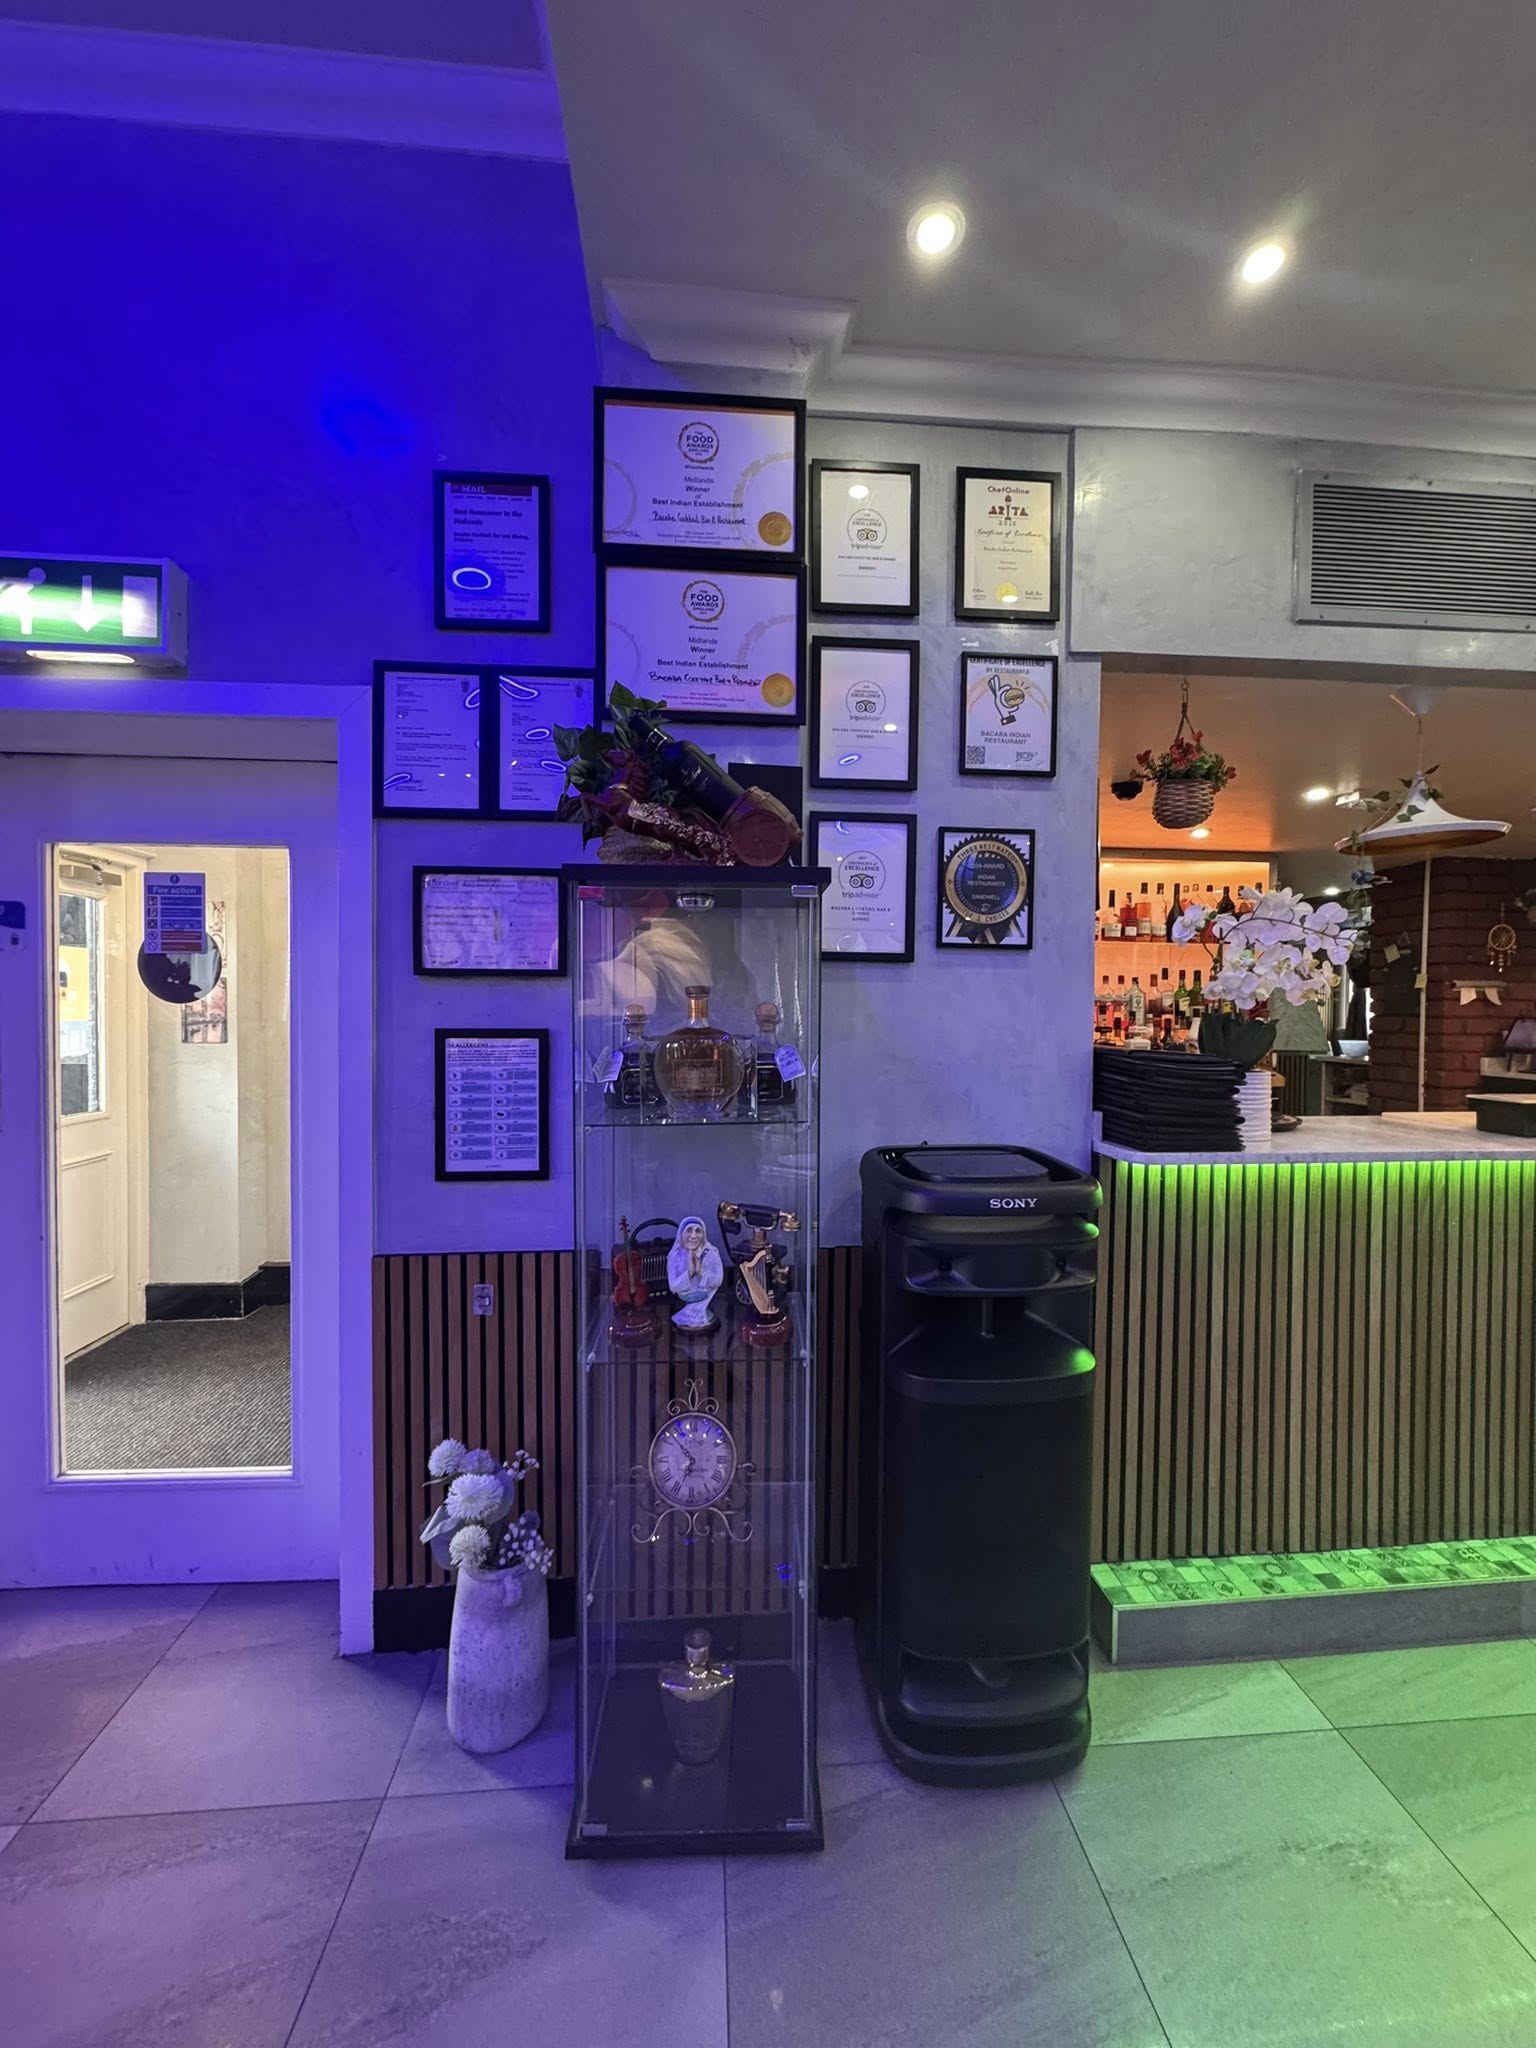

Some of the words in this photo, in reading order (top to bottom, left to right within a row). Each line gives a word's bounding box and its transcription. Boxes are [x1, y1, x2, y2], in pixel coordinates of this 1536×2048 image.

[686, 435, 714, 444] FOOD
[684, 476, 714, 484] Midlands
[988, 486, 1030, 494] ChefOnline
[694, 500, 743, 508] Establishment
[690, 594, 718, 602] FOOD
[690, 646, 716, 654] Winner
[698, 661, 748, 670] Establishment
[980, 730, 1008, 738] BACABA
[958, 844, 978, 860] THREE
[152, 886, 169, 894] Fire
[170, 886, 197, 894] action
[842, 891, 880, 899] tripadvisor
[990, 1198, 1038, 1208] SONY
